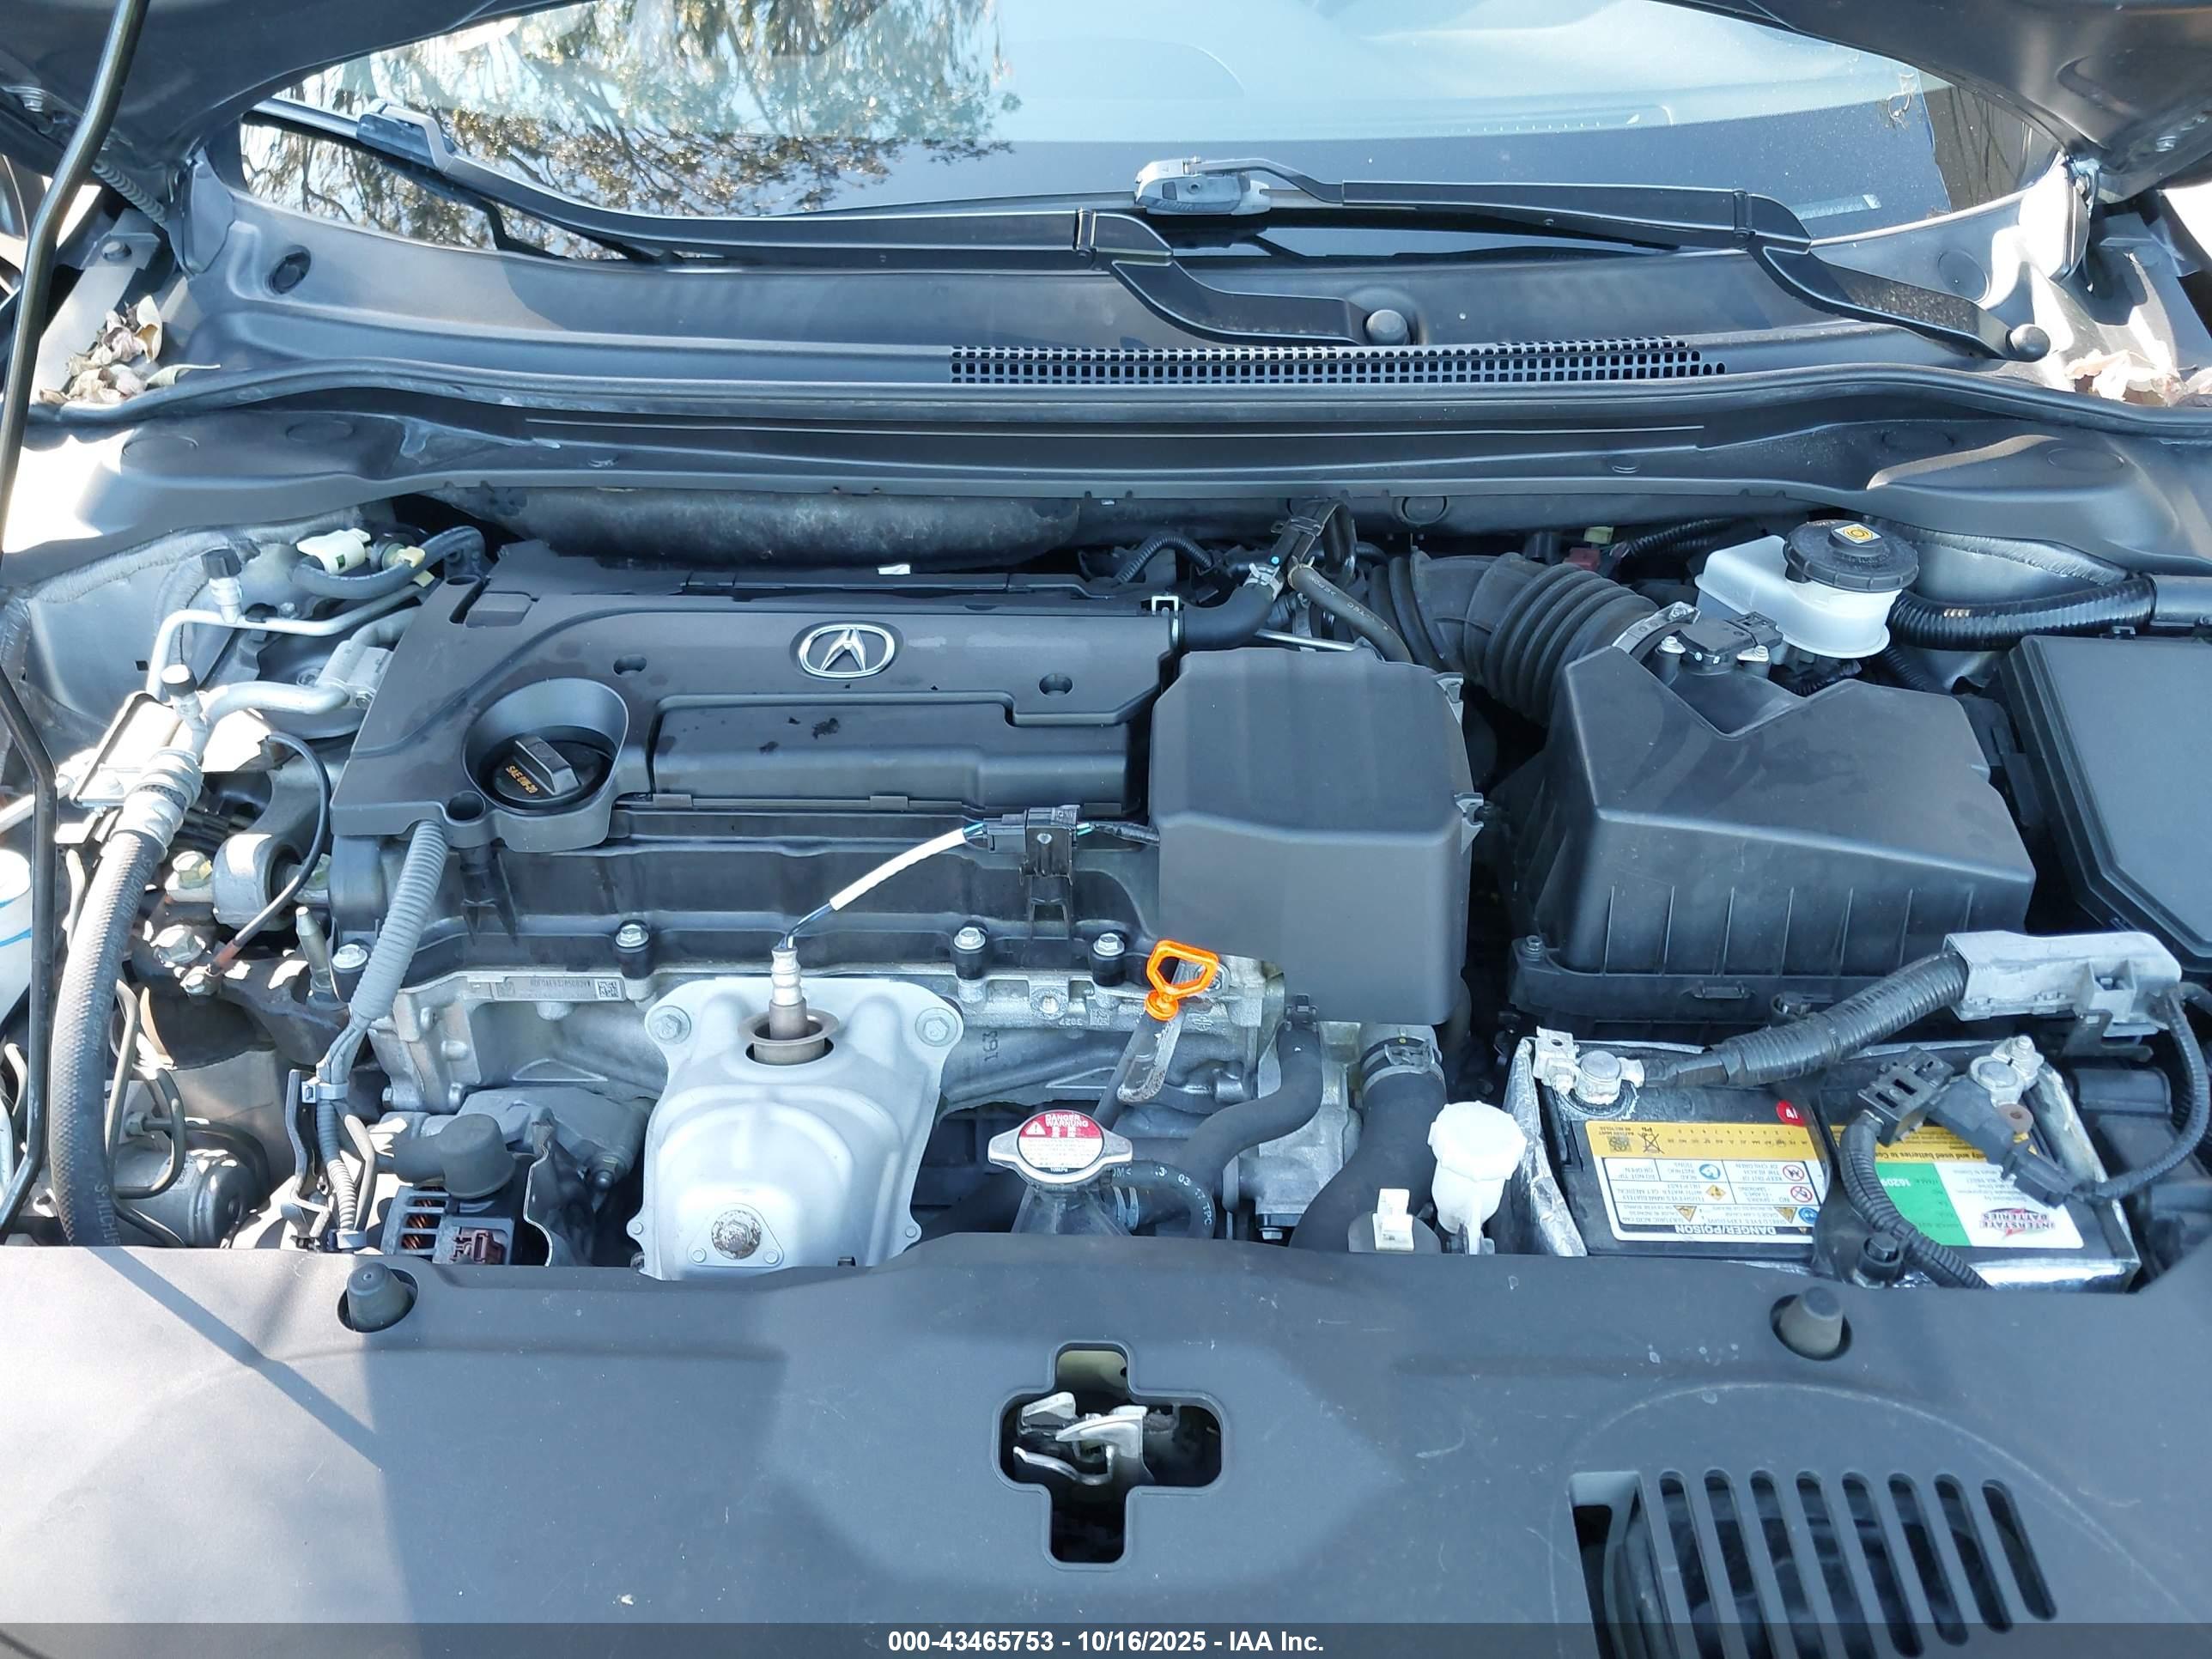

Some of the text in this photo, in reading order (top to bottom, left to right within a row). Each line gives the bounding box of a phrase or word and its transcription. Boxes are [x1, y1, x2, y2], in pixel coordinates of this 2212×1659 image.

[505, 765, 523, 779] SAE
[1202, 1202, 1212, 1226] TPC
[1674, 1224, 1777, 1235] DANGER/POISON
